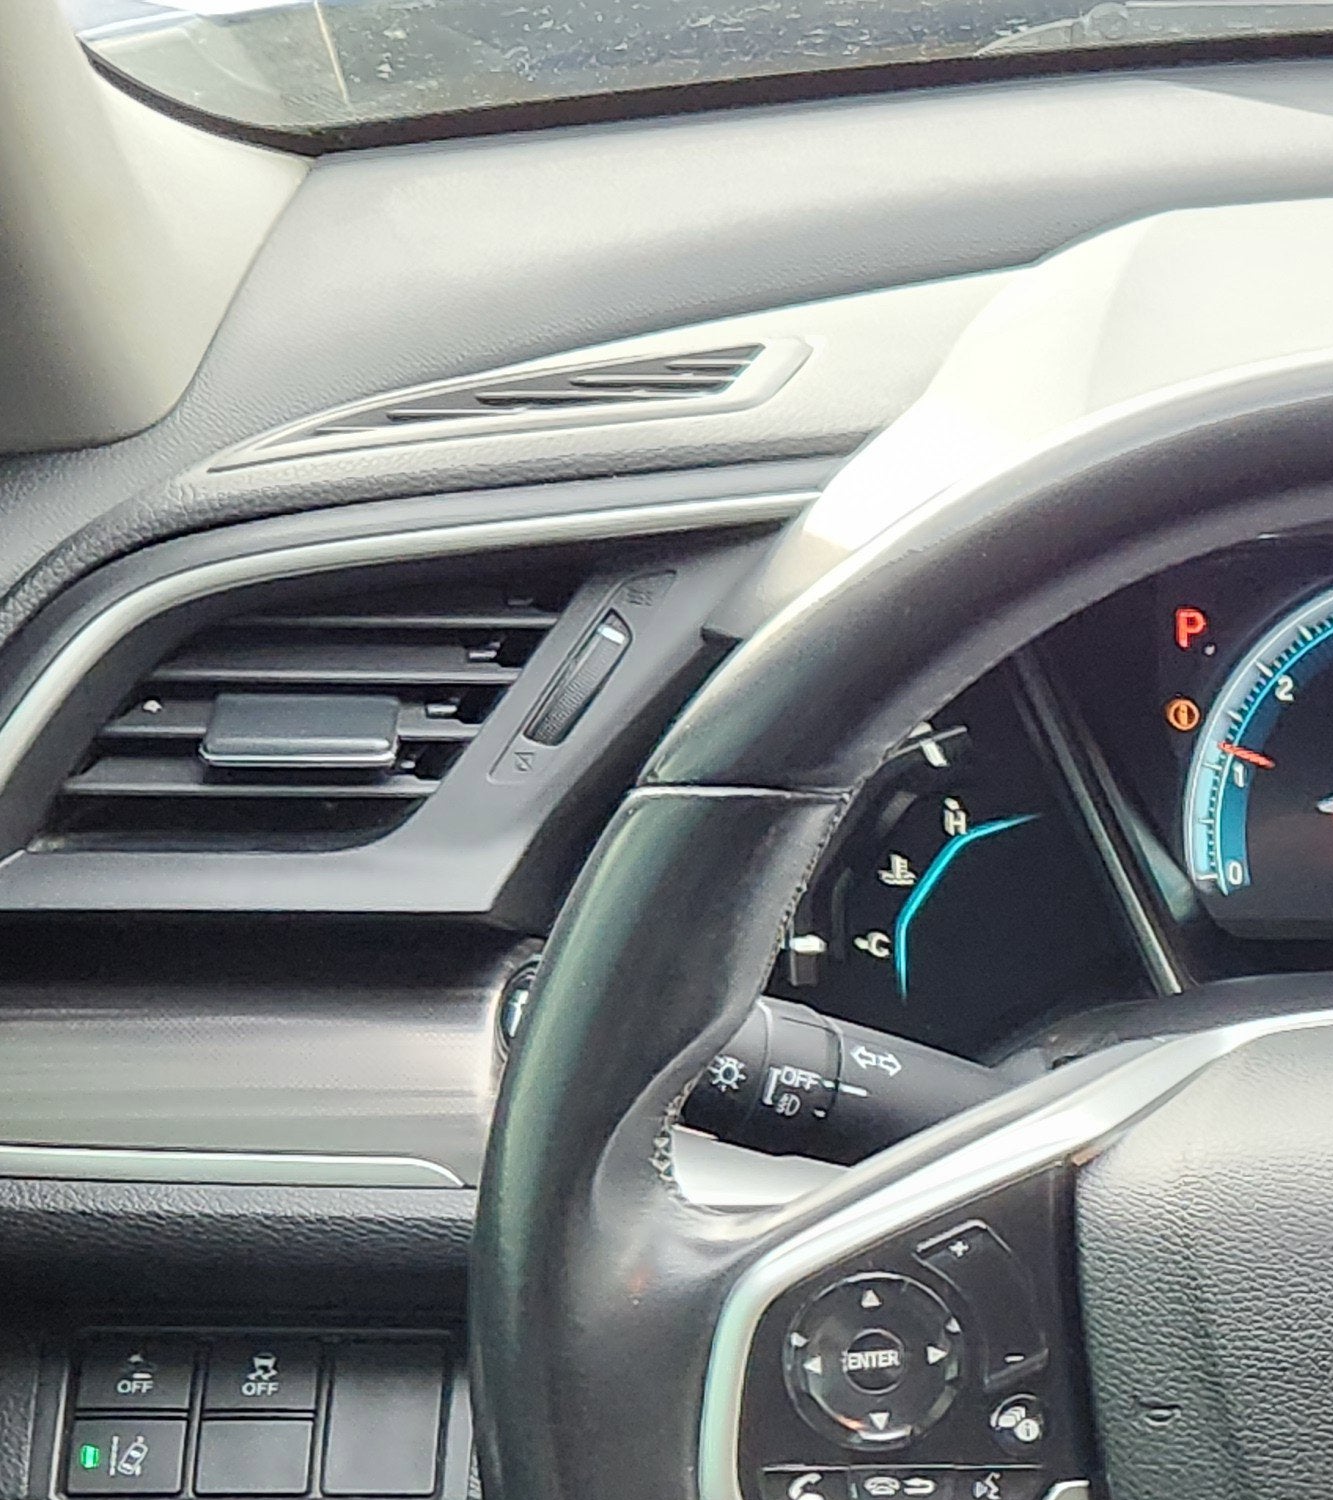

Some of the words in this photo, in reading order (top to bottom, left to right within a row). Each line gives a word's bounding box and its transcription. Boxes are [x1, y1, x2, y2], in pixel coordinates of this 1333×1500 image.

[1175, 608, 1206, 649] P
[1274, 676, 1295, 702] 2
[943, 807, 967, 836] H
[1227, 862, 1243, 885] 0
[780, 1065, 821, 1090] OFF
[847, 1349, 900, 1371] ENTER
[116, 1380, 153, 1395] OFF
[240, 1381, 279, 1396] OFF
